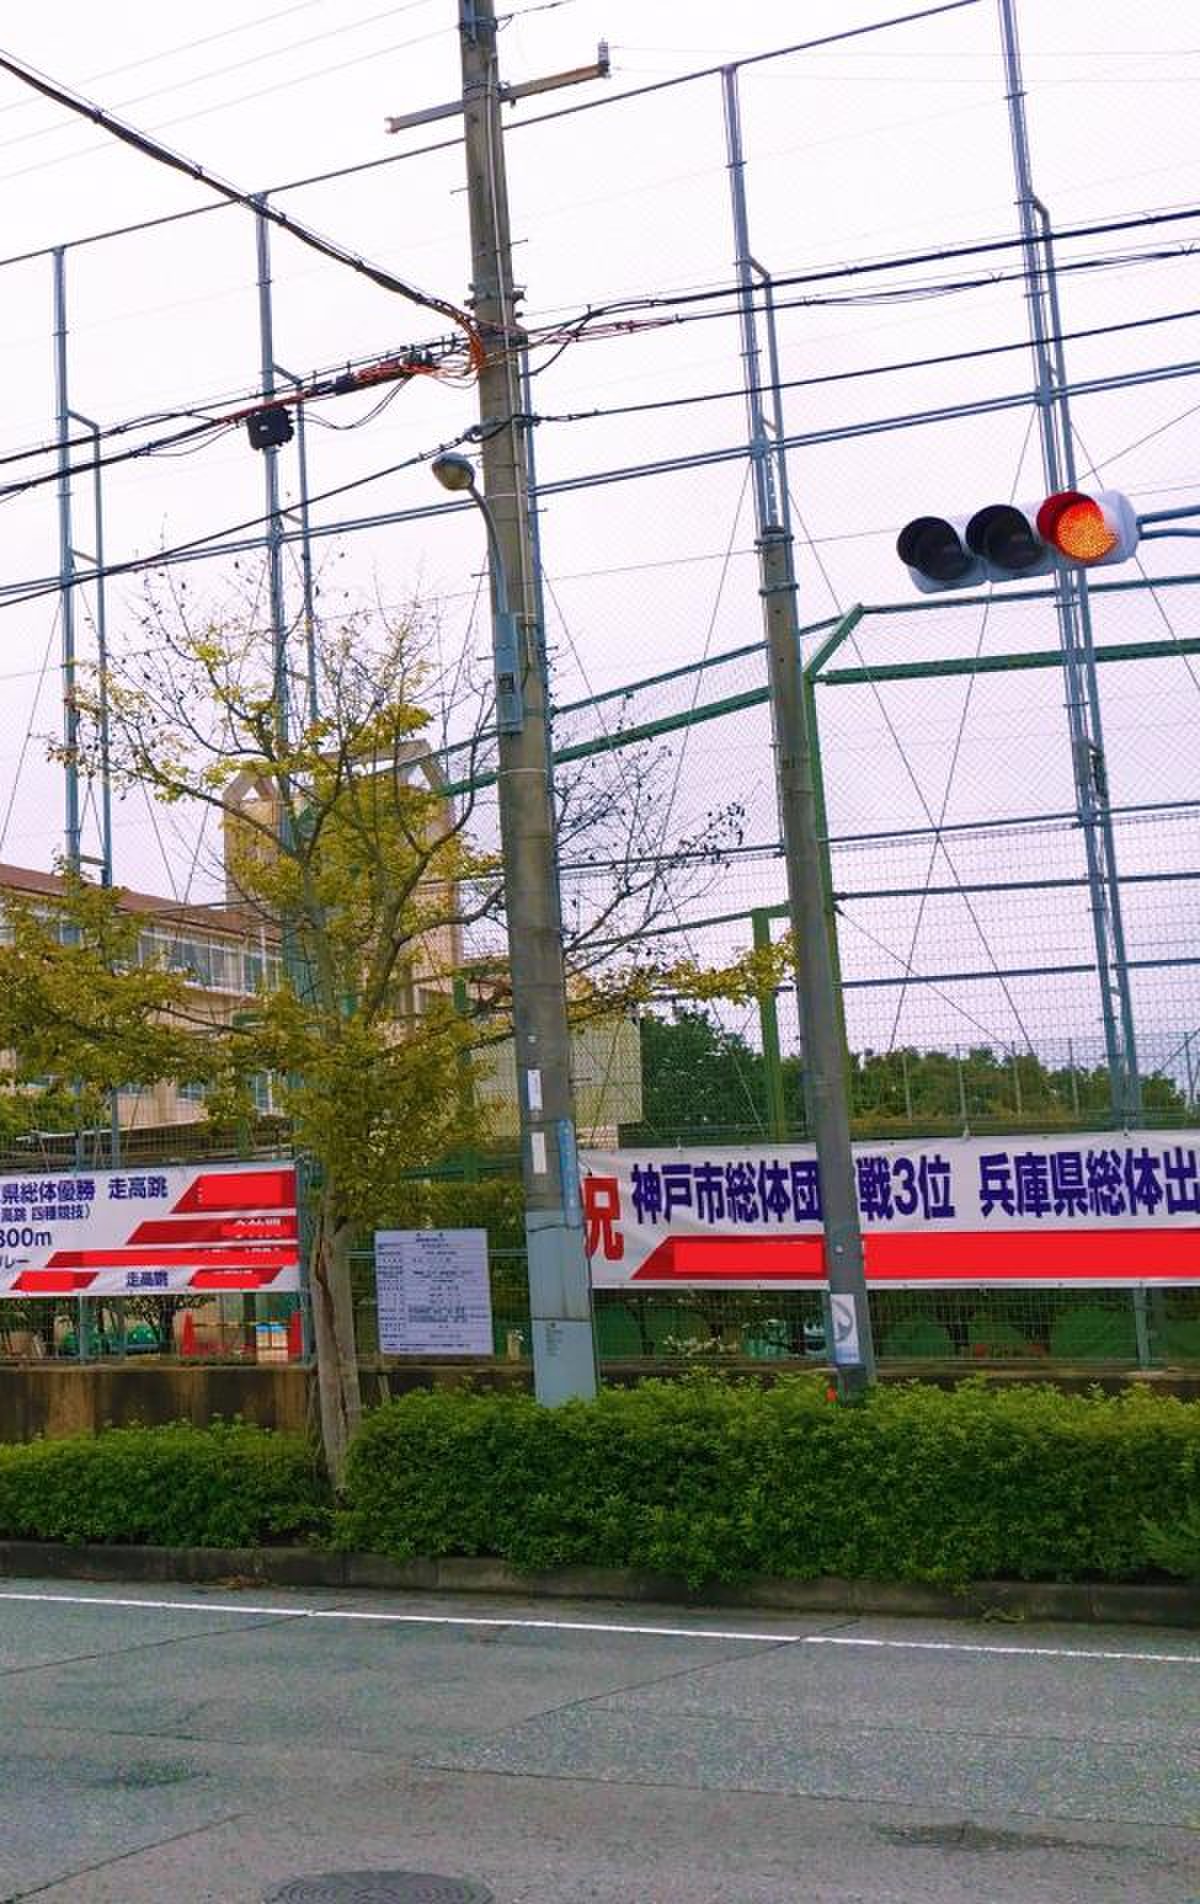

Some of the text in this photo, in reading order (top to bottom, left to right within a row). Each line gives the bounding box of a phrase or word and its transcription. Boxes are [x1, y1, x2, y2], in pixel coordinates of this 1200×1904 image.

[108, 1175, 169, 1201] 走高跳
[630, 1153, 956, 1226] 神戸市総体団戦3位
[978, 1146, 1200, 1218] 兵庫県総体出
[125, 1271, 169, 1287] 走高跳
